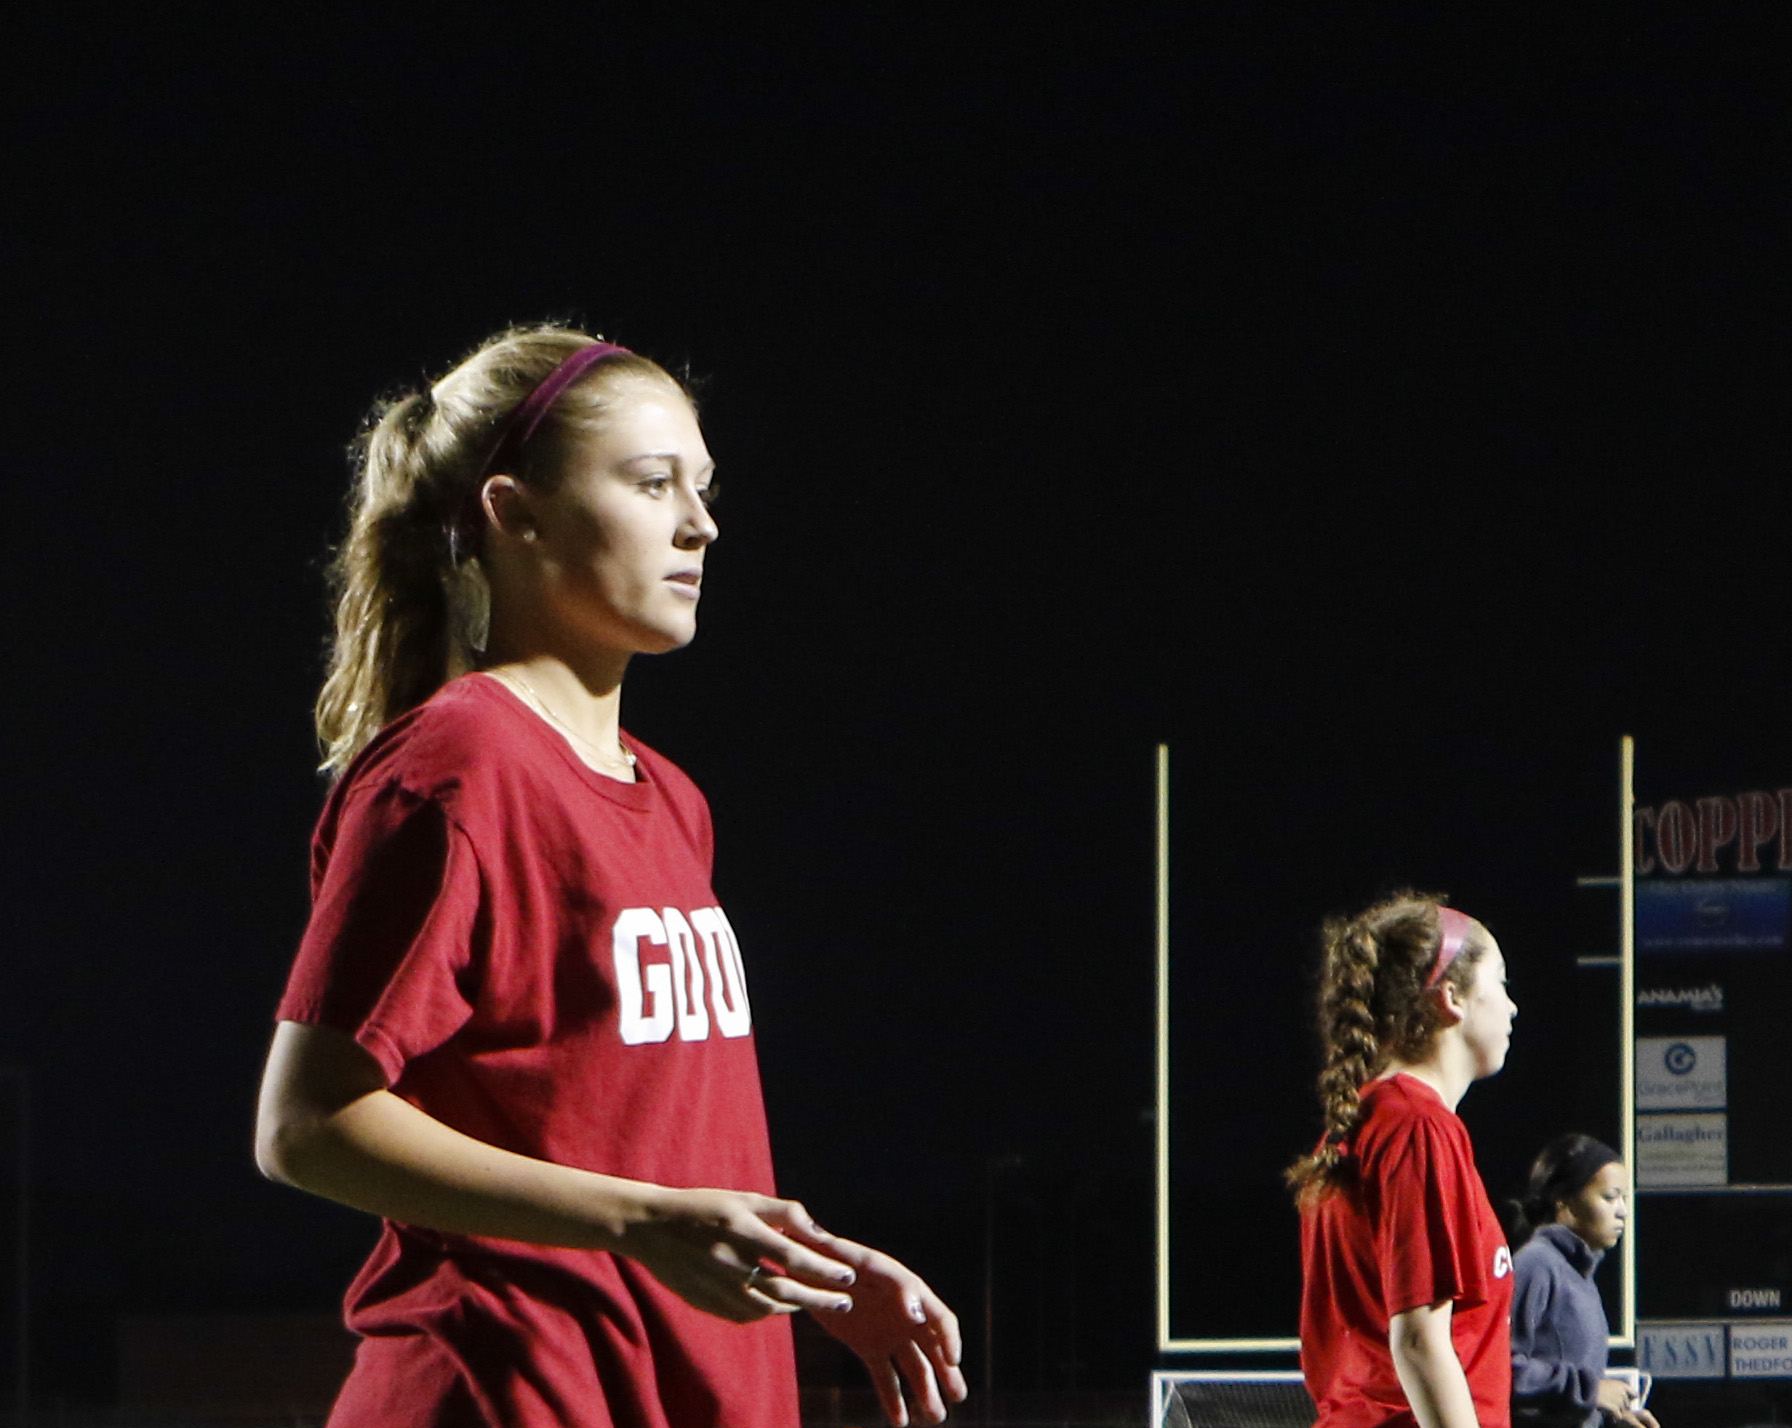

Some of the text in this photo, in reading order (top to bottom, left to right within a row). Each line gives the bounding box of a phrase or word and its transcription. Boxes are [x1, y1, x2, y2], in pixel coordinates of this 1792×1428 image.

[612, 907, 751, 1046] GOO
[1729, 1289, 1781, 1308] DOWN
[1732, 1336, 1787, 1350] ROGER
